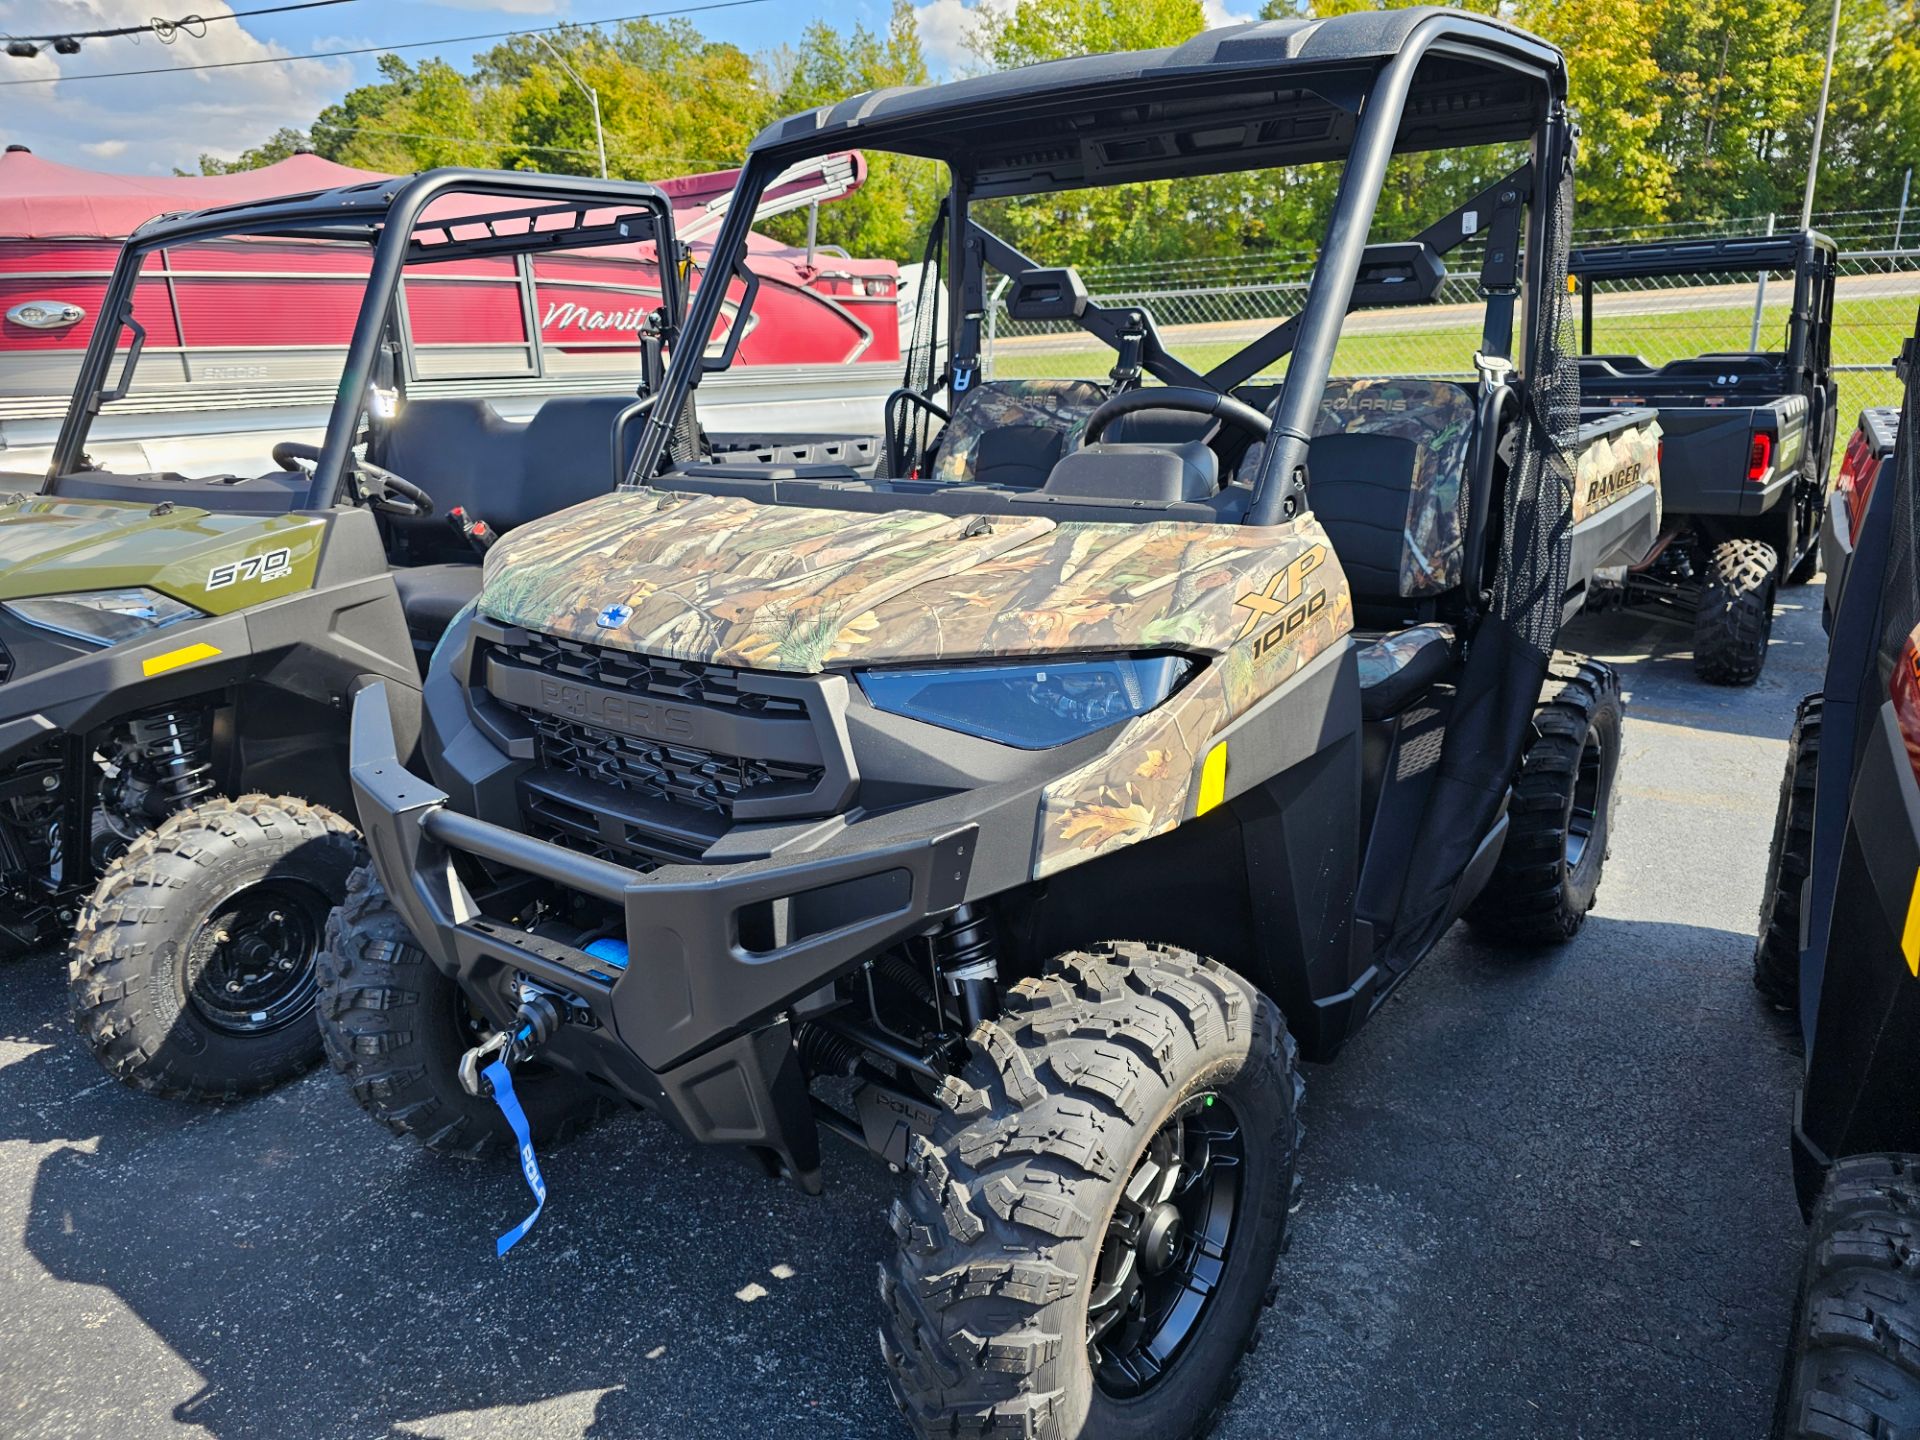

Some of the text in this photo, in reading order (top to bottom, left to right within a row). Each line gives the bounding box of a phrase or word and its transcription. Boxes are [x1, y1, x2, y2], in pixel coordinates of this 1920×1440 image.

[542, 302, 648, 331] Manit
[996, 394, 1057, 406] POLARIS
[1321, 397, 1407, 411] POLARIS
[1587, 462, 1641, 503] RANGER
[205, 546, 291, 592] 570
[1229, 542, 1327, 648] XP
[1252, 588, 1327, 661] 1000
[540, 678, 696, 742] POLARIS
[522, 1143, 547, 1232] POLA
